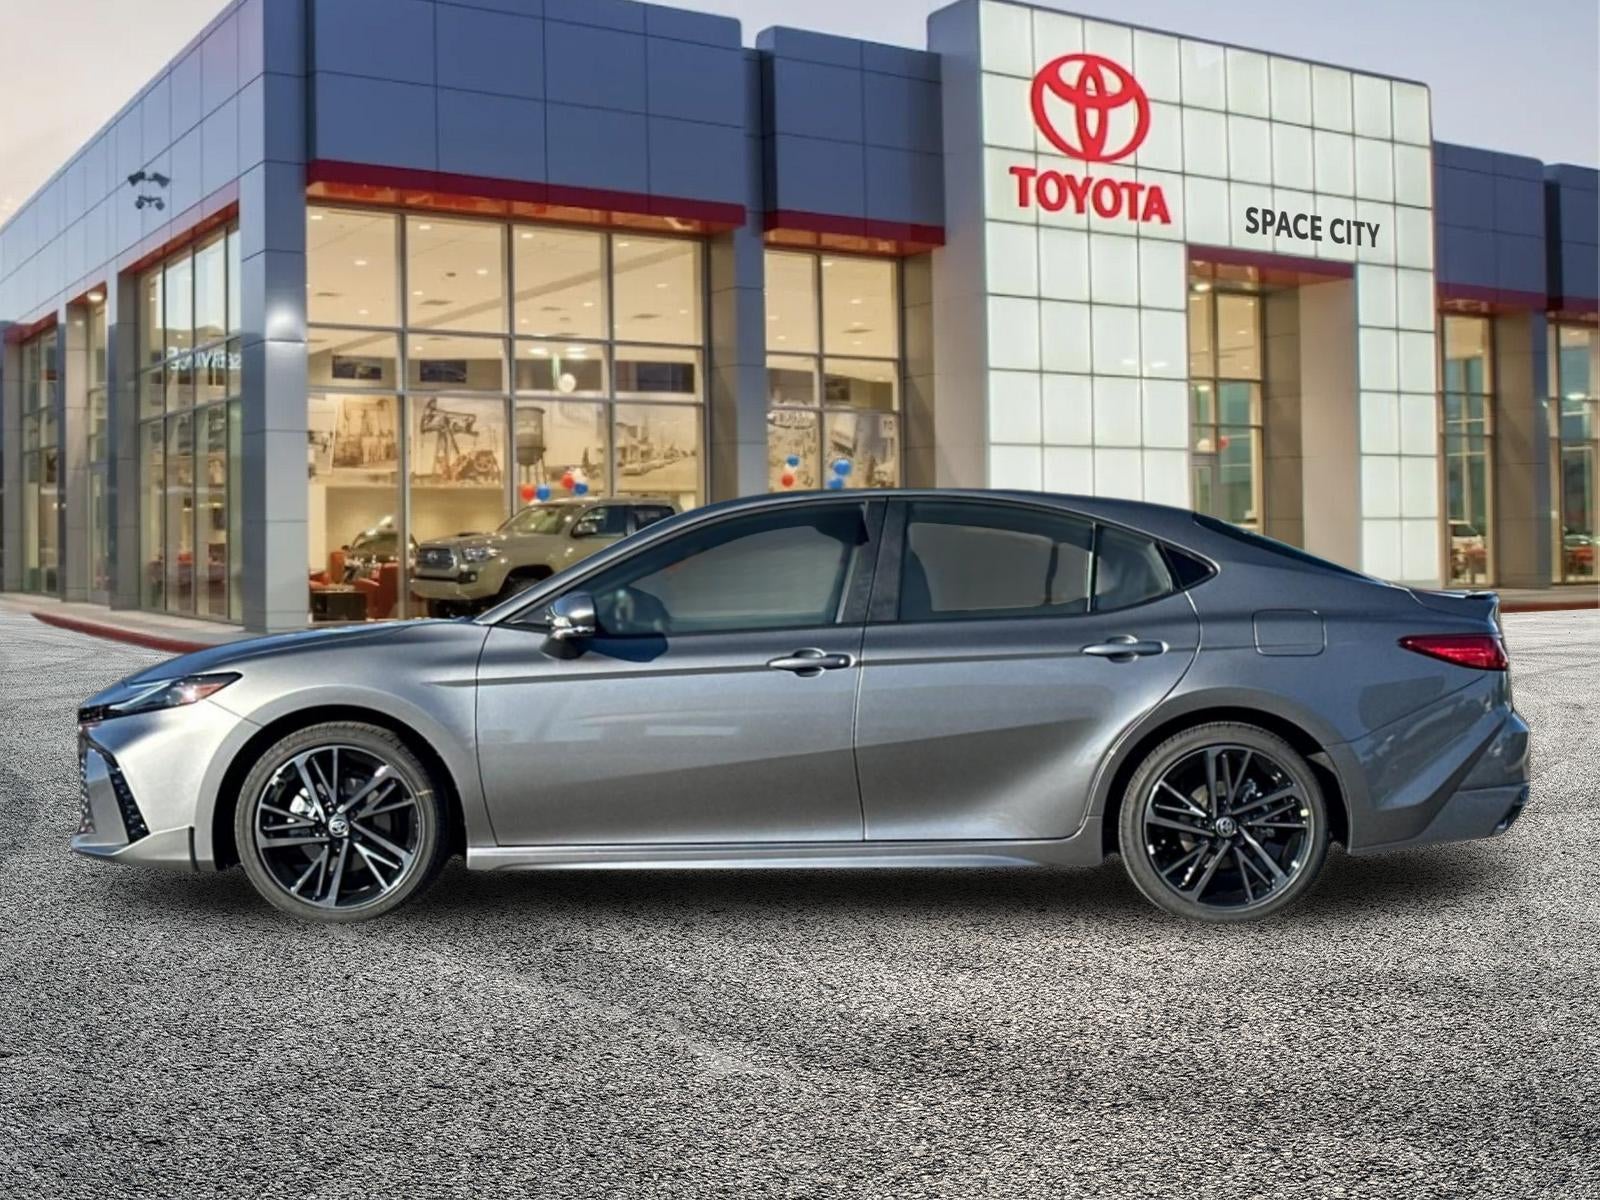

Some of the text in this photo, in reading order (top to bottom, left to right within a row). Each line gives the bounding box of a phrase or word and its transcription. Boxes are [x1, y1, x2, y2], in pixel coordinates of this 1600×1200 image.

[1009, 165, 1171, 225] TOYOTA
[1245, 206, 1381, 248] SPACE CITY
